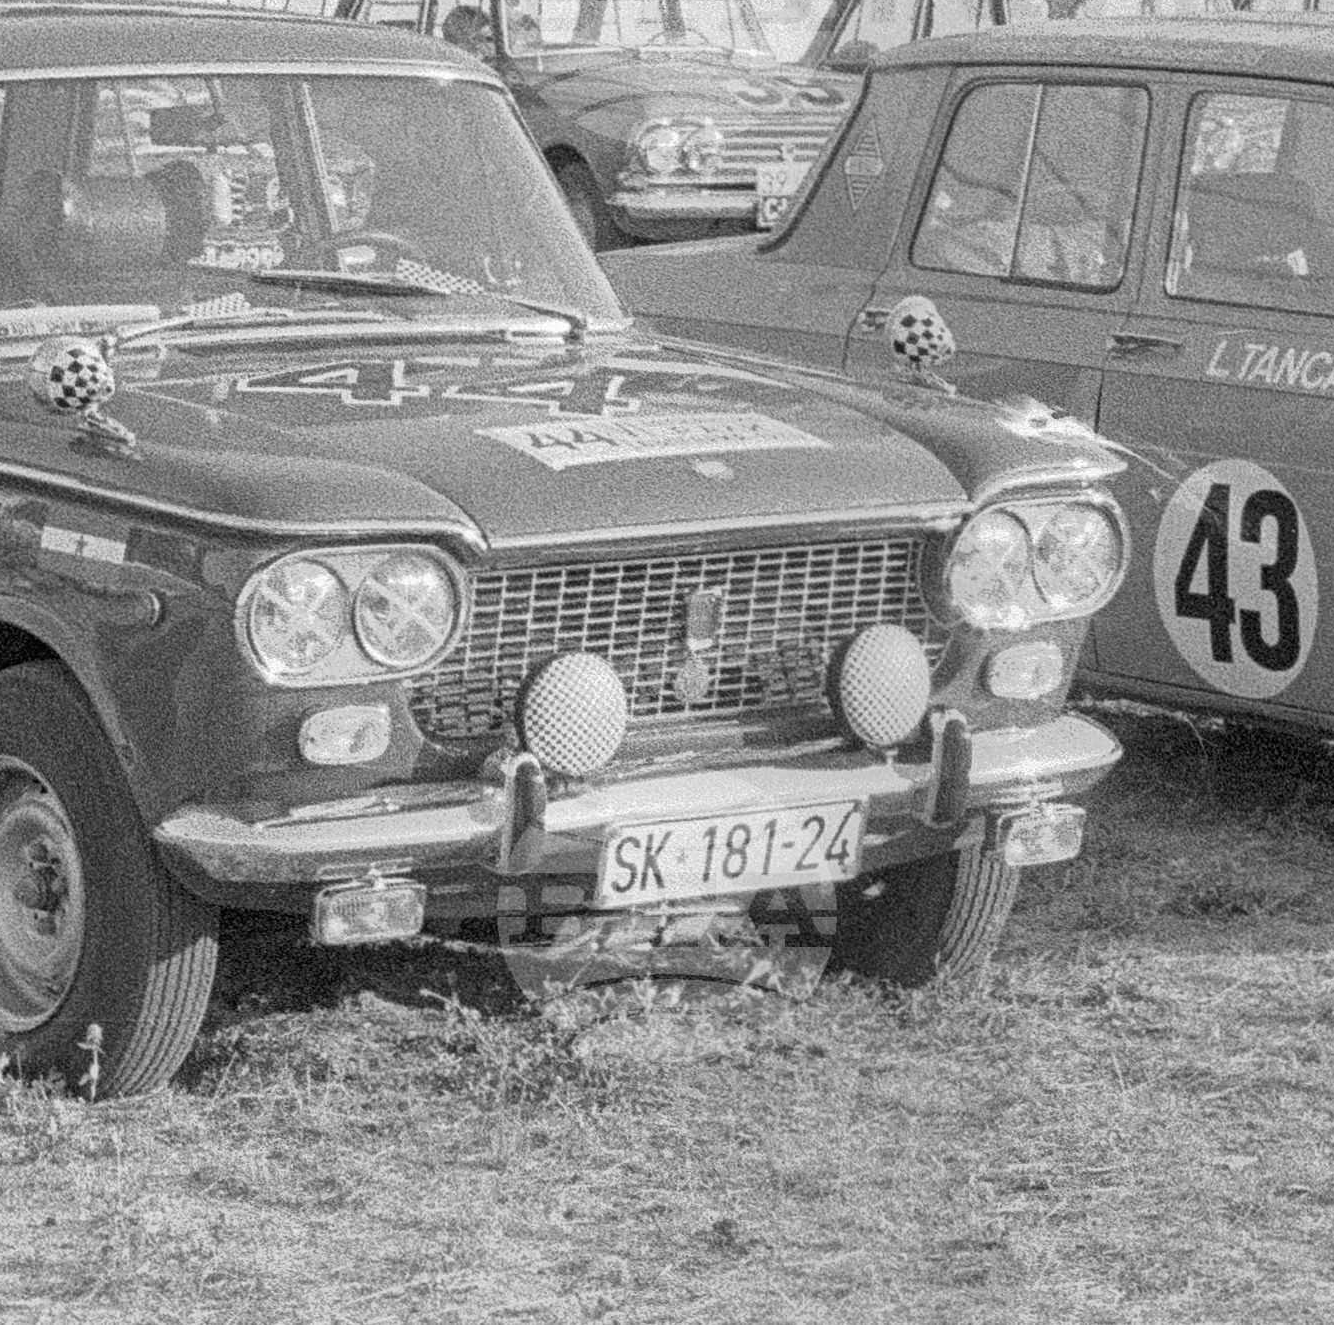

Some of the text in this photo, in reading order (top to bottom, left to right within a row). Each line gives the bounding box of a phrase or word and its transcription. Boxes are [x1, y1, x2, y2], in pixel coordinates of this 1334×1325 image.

[1174, 483, 1301, 672] 43
[610, 799, 862, 894] SK 181-24
